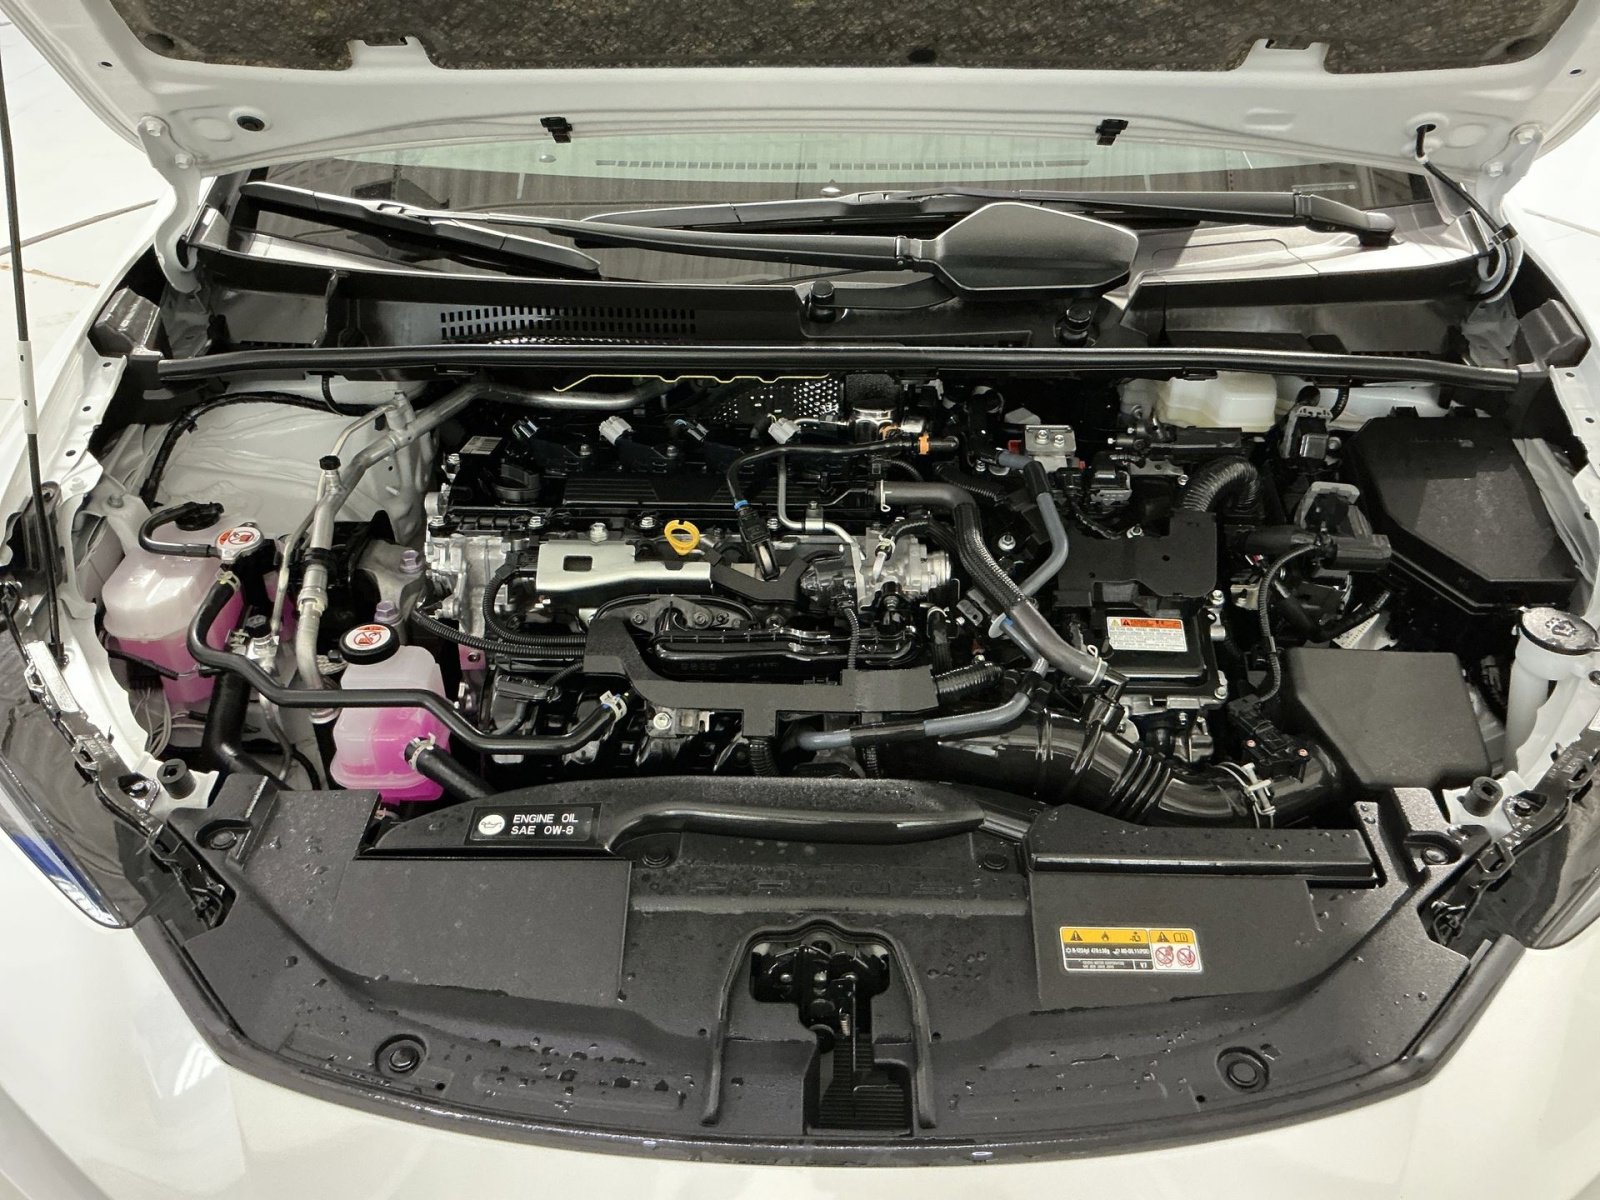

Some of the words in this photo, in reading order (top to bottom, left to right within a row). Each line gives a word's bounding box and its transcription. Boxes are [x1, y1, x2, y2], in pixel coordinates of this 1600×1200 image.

[513, 814, 554, 823] ENGINE
[561, 813, 579, 823] OIL
[511, 825, 536, 835] SAE
